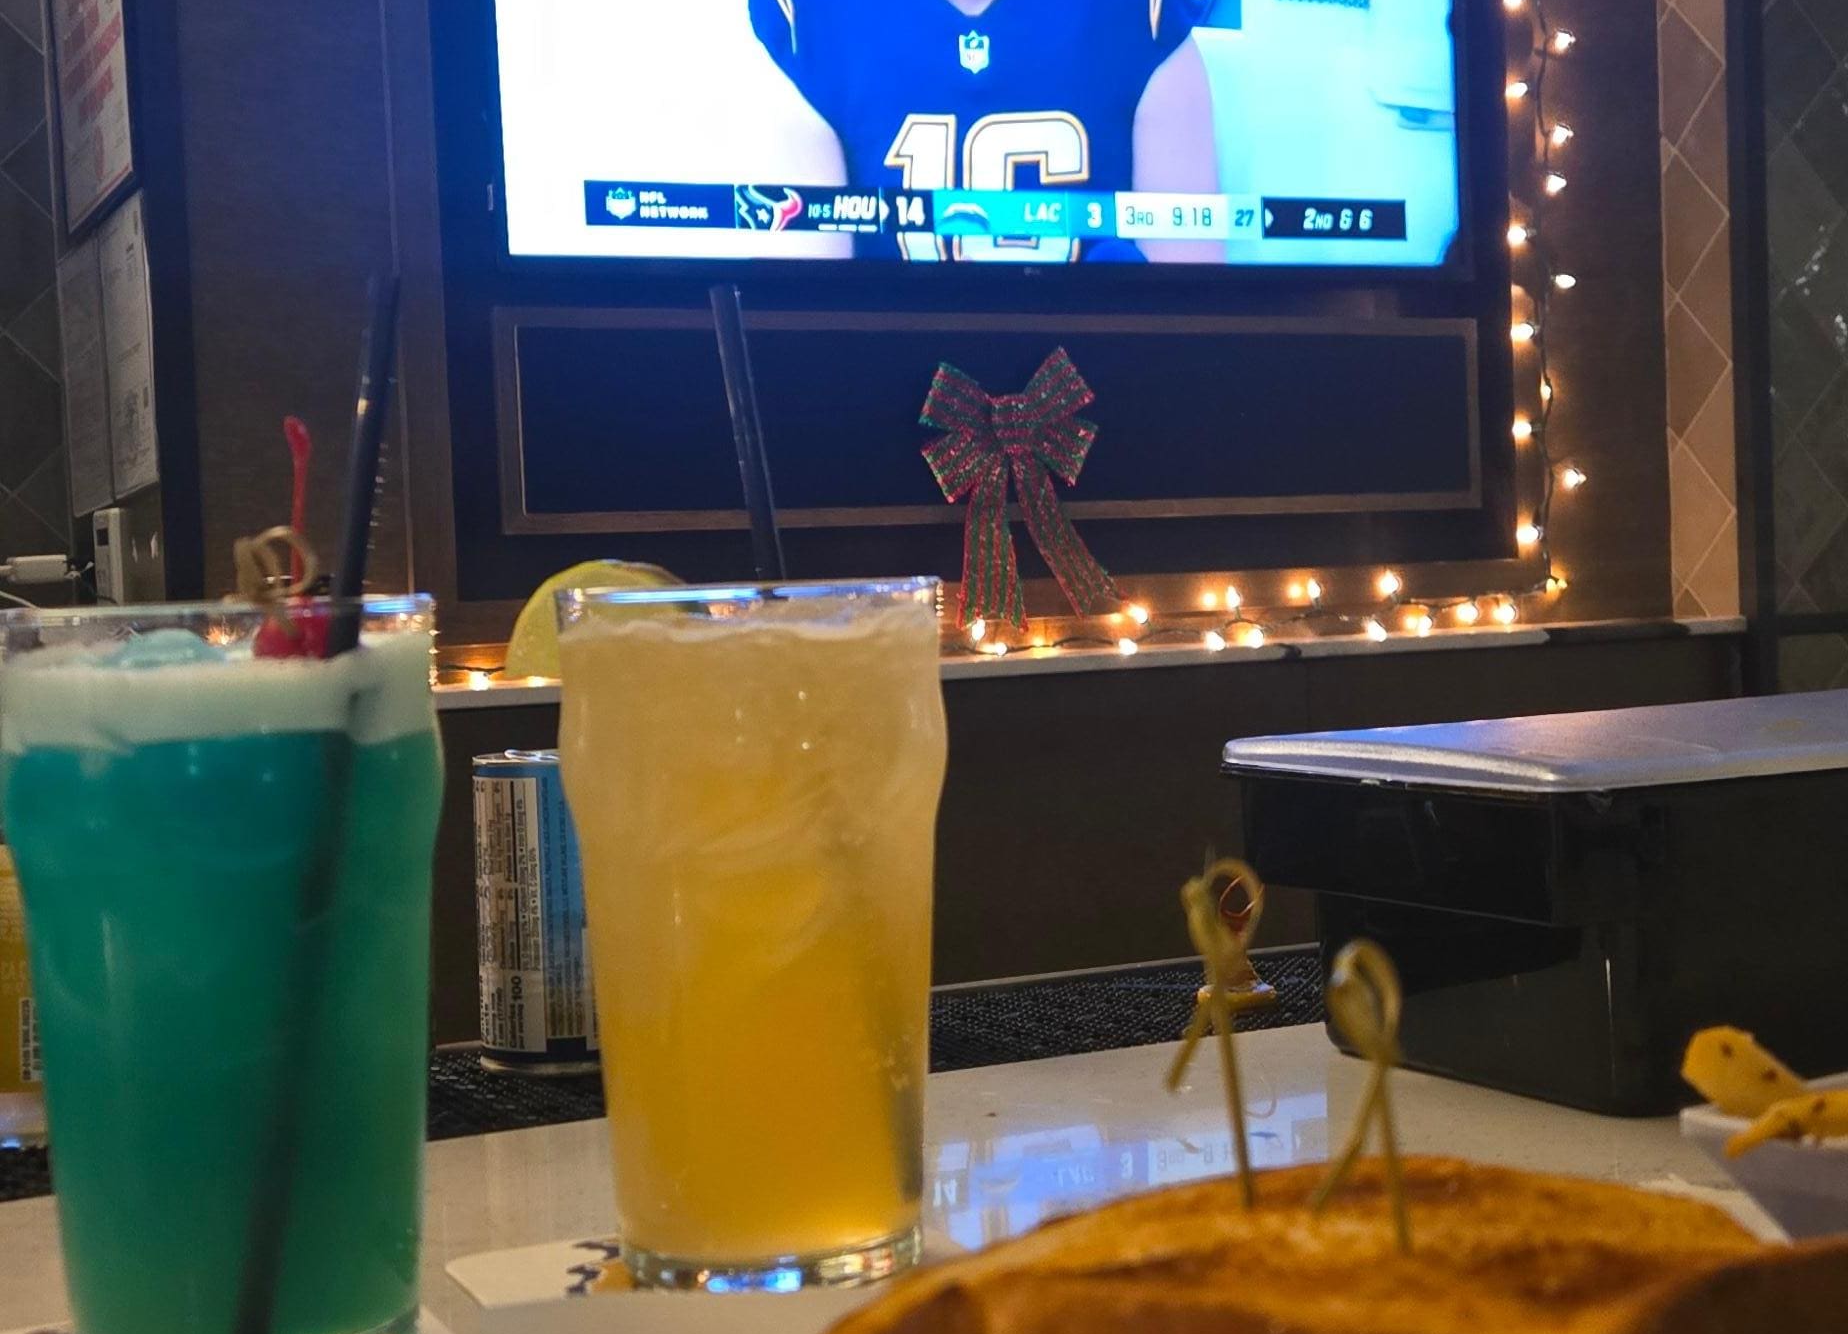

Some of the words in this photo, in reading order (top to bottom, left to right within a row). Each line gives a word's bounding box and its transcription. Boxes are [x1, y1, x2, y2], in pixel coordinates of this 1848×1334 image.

[639, 191, 667, 204] NFL
[639, 205, 709, 219] NETWORK
[833, 195, 877, 220] HOU
[895, 196, 926, 226] 14
[1024, 202, 1062, 222] LAC
[1087, 202, 1102, 228] 3
[1125, 206, 1154, 225] 3RD
[1234, 209, 1255, 227] 27
[1303, 207, 1334, 230] 2ND
[1359, 208, 1373, 231] 6
[510, 976, 523, 1001] 100
[508, 1004, 517, 1048] Calories
